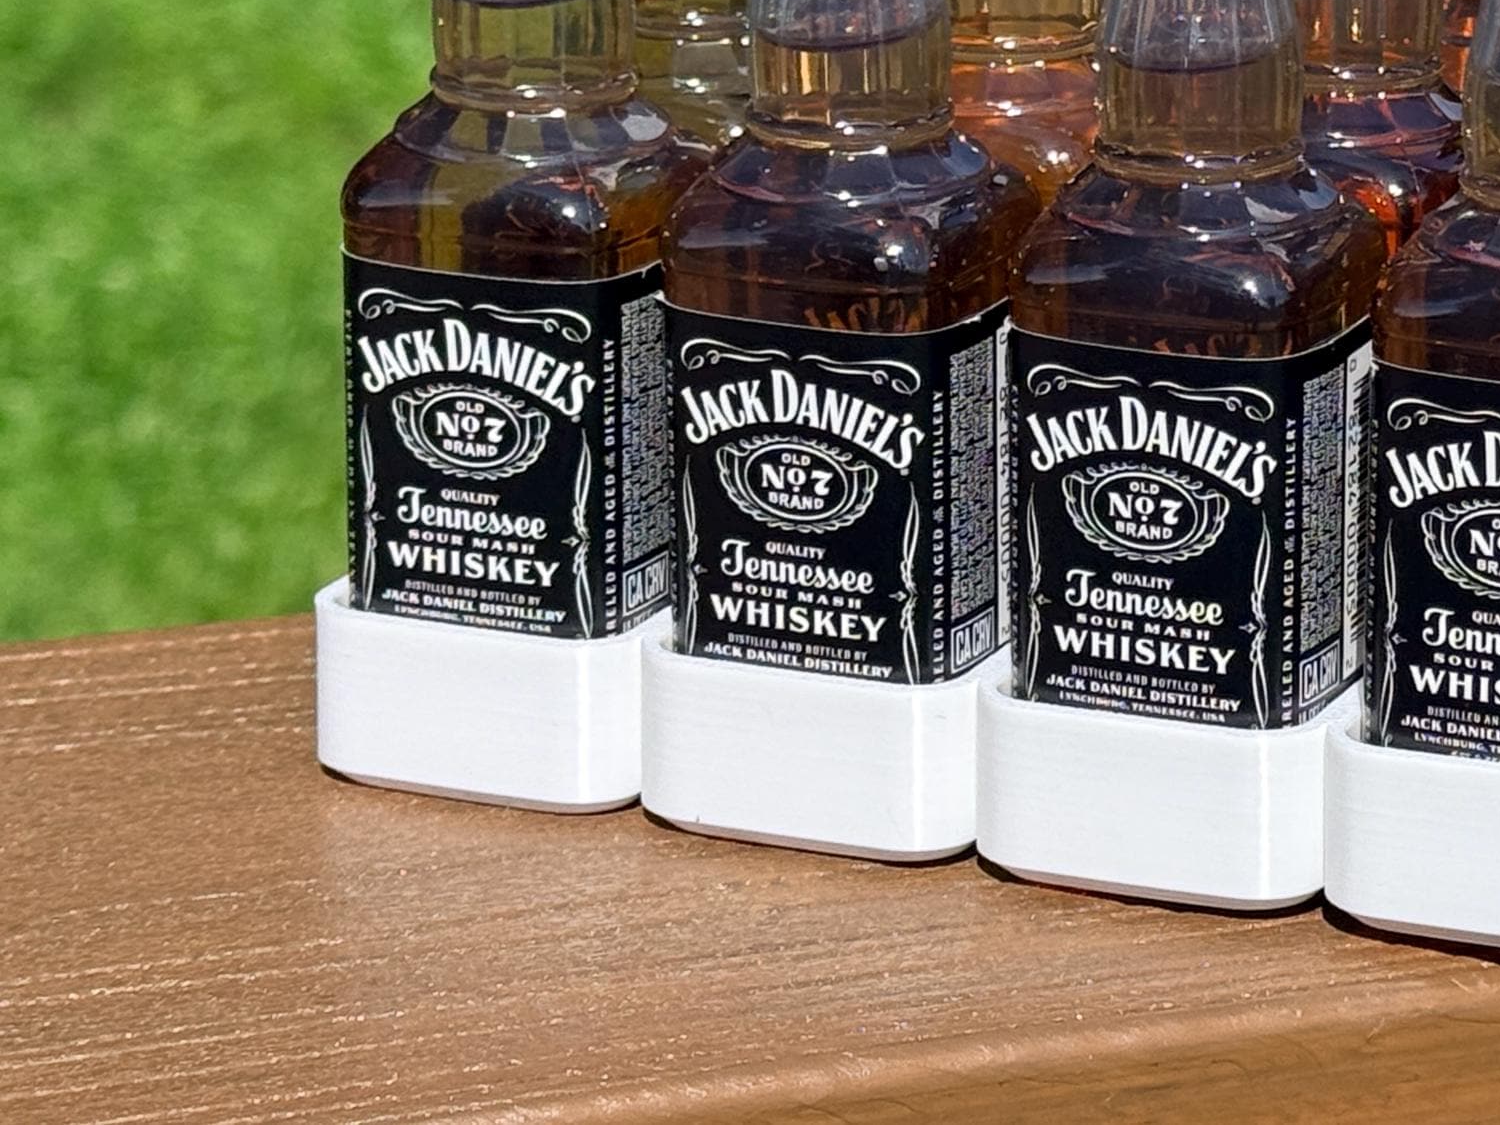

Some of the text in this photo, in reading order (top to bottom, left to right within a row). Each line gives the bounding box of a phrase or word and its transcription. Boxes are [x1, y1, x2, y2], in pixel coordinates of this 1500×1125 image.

[358, 319, 594, 416] JACK DANIEL'S
[456, 401, 484, 414] OLD
[604, 339, 616, 446] DISTILLERY
[681, 369, 924, 469] JACK DANIEL'S
[443, 439, 498, 457] BRAND
[782, 453, 810, 466] OLD
[933, 390, 944, 499] DISTILLERY
[1027, 396, 1277, 498] JACK DANIEL'S
[1130, 481, 1159, 495] OLD
[1284, 417, 1297, 529] DISTILLERY
[1386, 442, 1482, 508] JACK
[397, 487, 547, 539] Tennessee
[442, 489, 499, 505] QUALITY
[605, 474, 616, 521] AGED
[769, 492, 824, 510] BRAND
[409, 528, 463, 545] SOUR
[605, 529, 617, 564] AND
[1116, 521, 1173, 540] BRAND
[387, 541, 560, 587] WHISKEY
[721, 540, 874, 594] Tennessee
[766, 542, 826, 559] QUALITY
[933, 529, 944, 577] AGED
[732, 582, 862, 609] SOUR MASH
[1065, 570, 1224, 625] Tennessee
[1112, 572, 1174, 590] QUALITY
[1283, 559, 1294, 608] AGED
[383, 588, 419, 602] JACK
[423, 594, 476, 612] DANIEL
[480, 603, 566, 624] DISTILLERY
[710, 594, 886, 642] WHISKEY
[933, 584, 945, 621] AND
[1076, 613, 1210, 641] SOUR MASH
[1283, 616, 1294, 652] AND
[705, 641, 893, 679] JACK DANIEL DISTILLERY
[728, 632, 778, 649] DISTILLED
[781, 642, 802, 651] AND
[806, 644, 851, 660] BOTTLED
[1053, 625, 1236, 675] WHISKEY
[1433, 653, 1493, 671] SOUR
[1047, 674, 1241, 712] JACK DANIEL DISTILLERY
[1071, 665, 1216, 695] DISTILLED AND BOTTLED BY
[1401, 715, 1442, 731] JACK
[1428, 706, 1481, 723] DISTILLED
